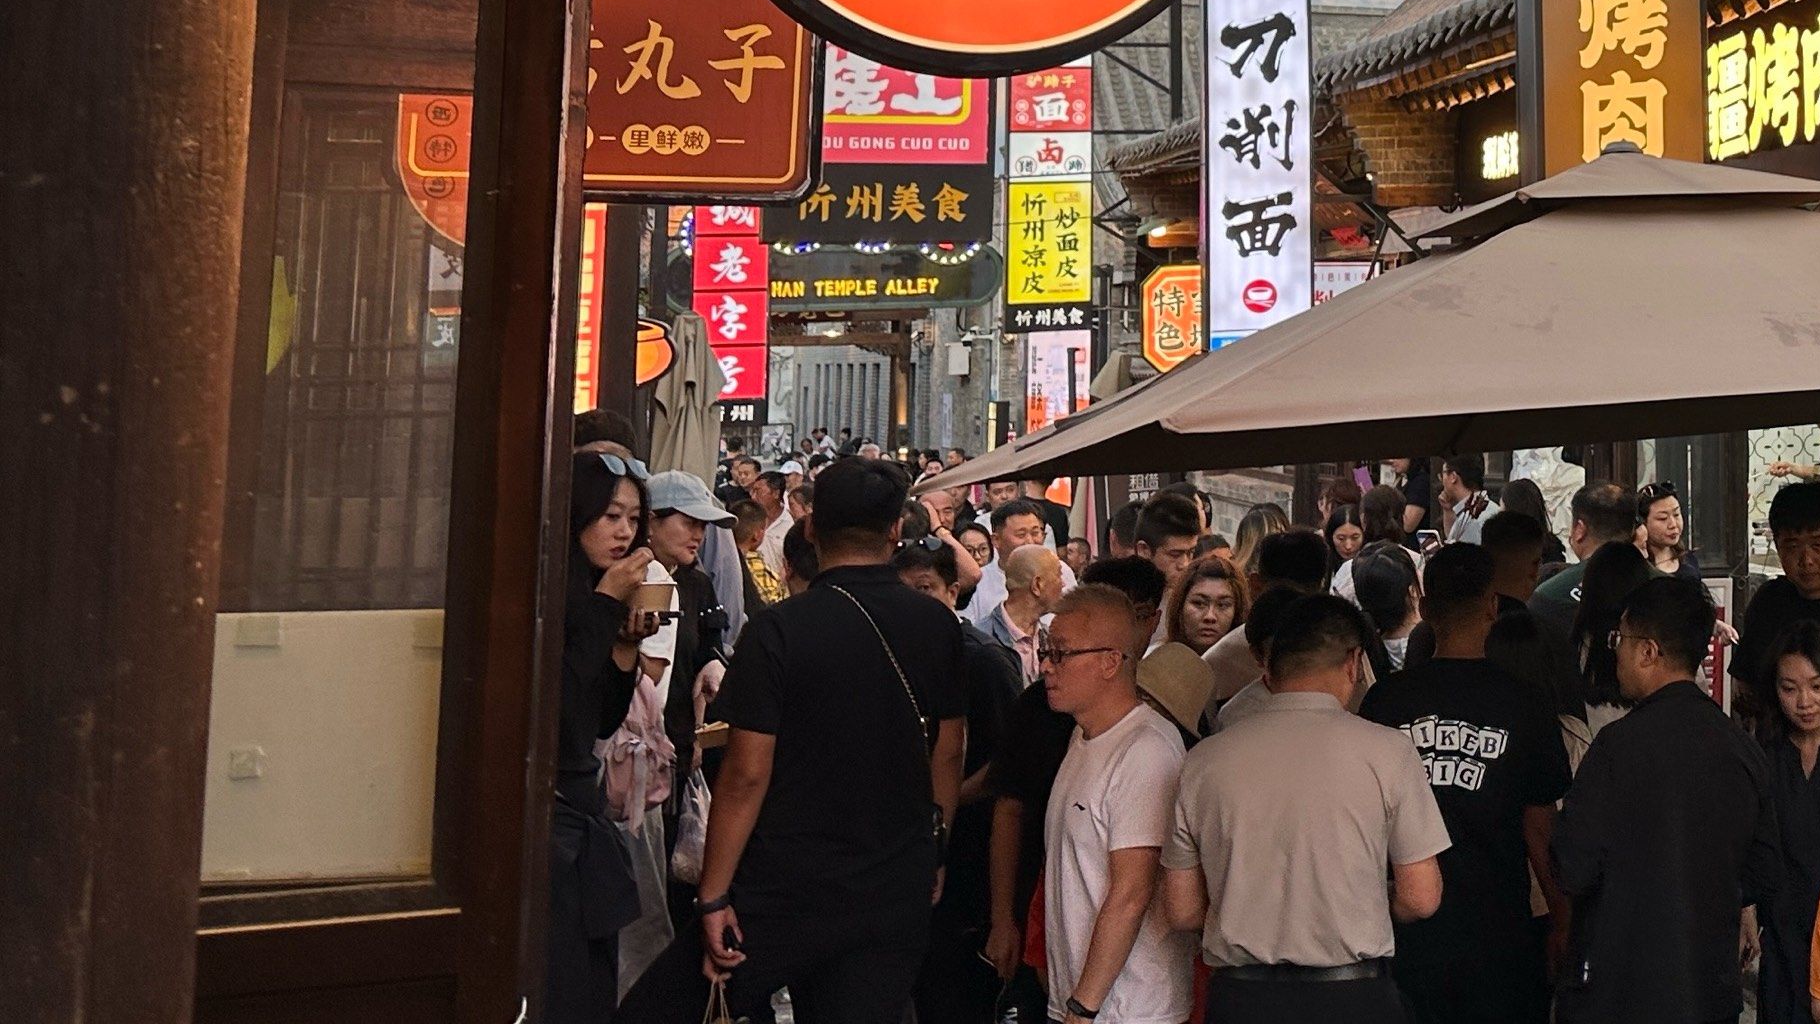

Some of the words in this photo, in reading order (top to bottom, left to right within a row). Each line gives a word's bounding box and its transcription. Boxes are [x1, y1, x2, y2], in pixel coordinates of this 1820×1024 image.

[588, 18, 786, 103] 丸子
[1032, 91, 1070, 122] 面
[1216, 11, 1299, 257] 刀削面
[628, 129, 704, 150] 里鲜嫩
[849, 137, 896, 150] GONG
[901, 137, 933, 150] CUO
[938, 137, 970, 150] CUO
[799, 180, 969, 223] 忻州美食
[1021, 192, 1048, 295] 忻州凉皮
[1055, 206, 1081, 278] 炒面皮
[771, 280, 805, 299] HAN
[813, 278, 877, 298] TEMPLE
[884, 277, 939, 296] ALLEY
[1153, 284, 1187, 352] 特色
